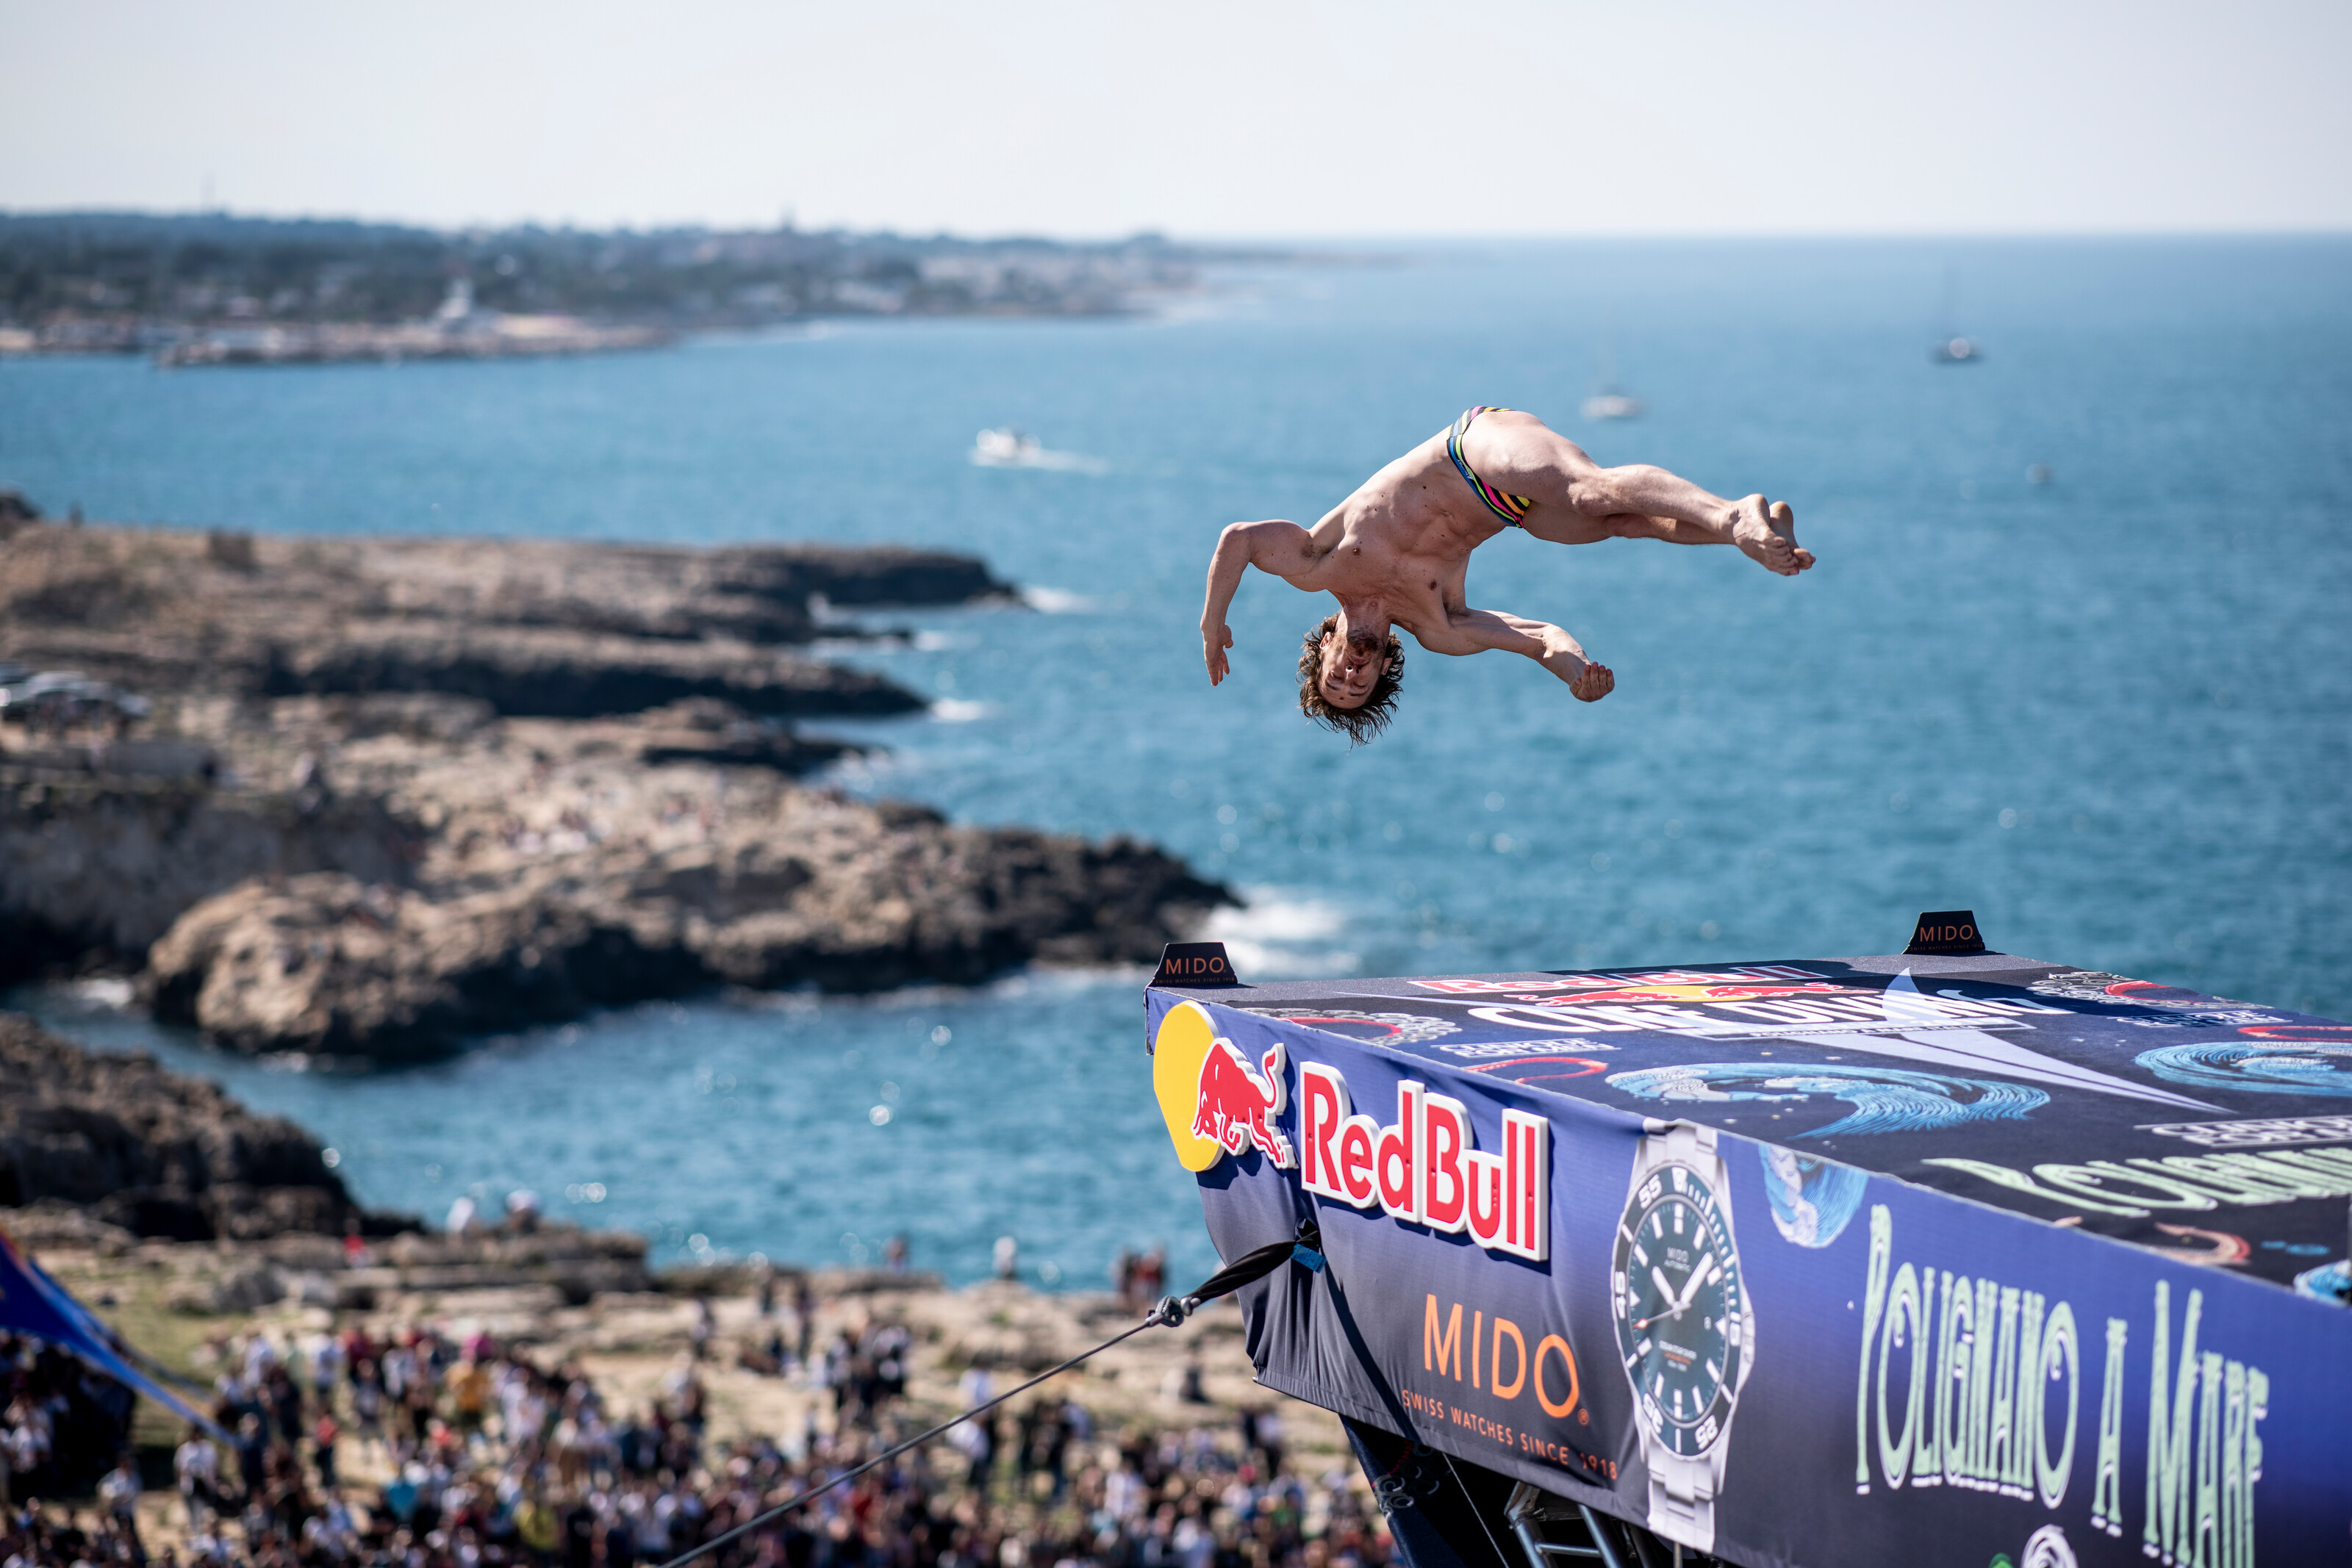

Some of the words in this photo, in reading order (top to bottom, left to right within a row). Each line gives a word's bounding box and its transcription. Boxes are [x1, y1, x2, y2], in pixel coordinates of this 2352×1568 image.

[1919, 924, 1974, 942] MIDO
[1165, 956, 1225, 975] MIDO
[1467, 1004, 1738, 1033] CLIFF
[1702, 988, 2074, 1024] DIVING
[2116, 1012, 2266, 1024] CLINIQUE
[1909, 1018, 2005, 1026] 2019
[1439, 1039, 1598, 1053] CLINIQUE
[1454, 1048, 1532, 1058] FOR
[1531, 1043, 1615, 1052] MEN
[1638, 1173, 1663, 1209] 55
[1857, 1204, 2079, 1508] POLIGNANO
[2090, 1316, 2128, 1537] A
[1401, 1389, 1445, 1420] SWISS
[1450, 1406, 1514, 1446] WATCHES
[1519, 1432, 1569, 1465] SINCE
[1580, 1452, 1618, 1480] 1918
